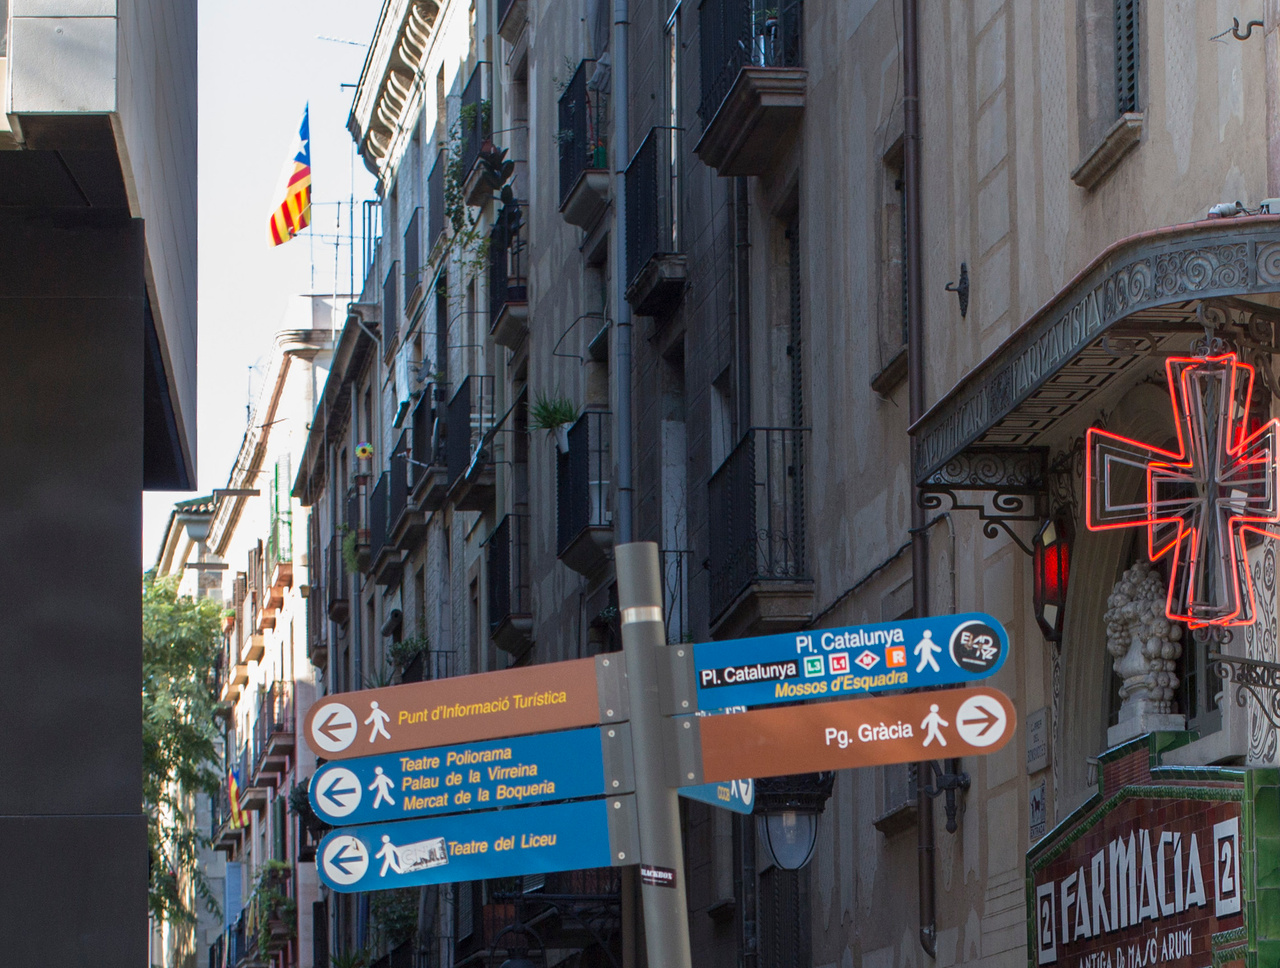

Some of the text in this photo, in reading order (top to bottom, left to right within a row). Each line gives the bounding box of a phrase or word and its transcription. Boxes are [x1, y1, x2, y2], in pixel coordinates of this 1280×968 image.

[796, 628, 904, 654] Pl. Catalunya
[702, 662, 796, 686] Pl. Catalunya
[807, 660, 822, 673] L3
[832, 656, 846, 670] L1
[774, 670, 908, 698] Mossos d'Esquadra
[398, 690, 567, 725] Punt d'Informació Turística
[825, 721, 914, 748] Pg. Gràcia
[400, 748, 512, 772] Teatre Poliorama
[402, 764, 538, 791] Palau de la Virreina
[403, 780, 556, 810] Mercat de la Boqueria
[448, 840, 488, 856] Teatre
[494, 836, 515, 851] del
[520, 832, 556, 848] Liceu
[1222, 841, 1234, 893] 2
[1042, 900, 1050, 945] 2
